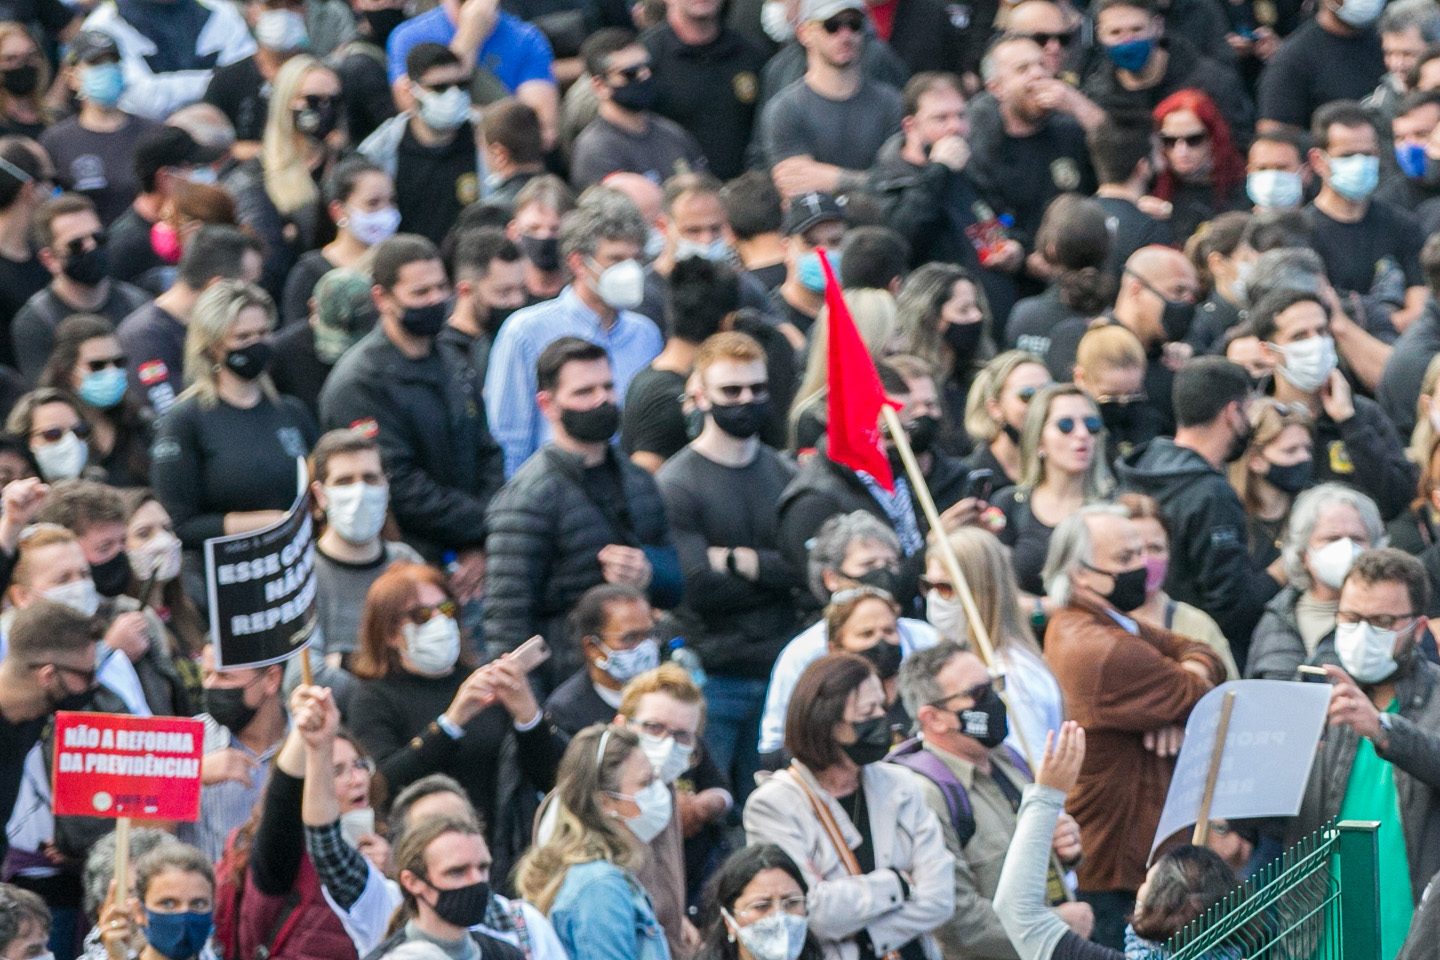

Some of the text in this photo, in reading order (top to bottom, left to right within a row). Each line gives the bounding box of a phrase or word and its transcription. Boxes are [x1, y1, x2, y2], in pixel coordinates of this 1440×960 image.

[218, 552, 281, 585] ESSE
[64, 724, 99, 749] NÃO
[116, 730, 194, 754] REFORMA
[59, 752, 200, 779] DA PREVIDÊNCIA!
